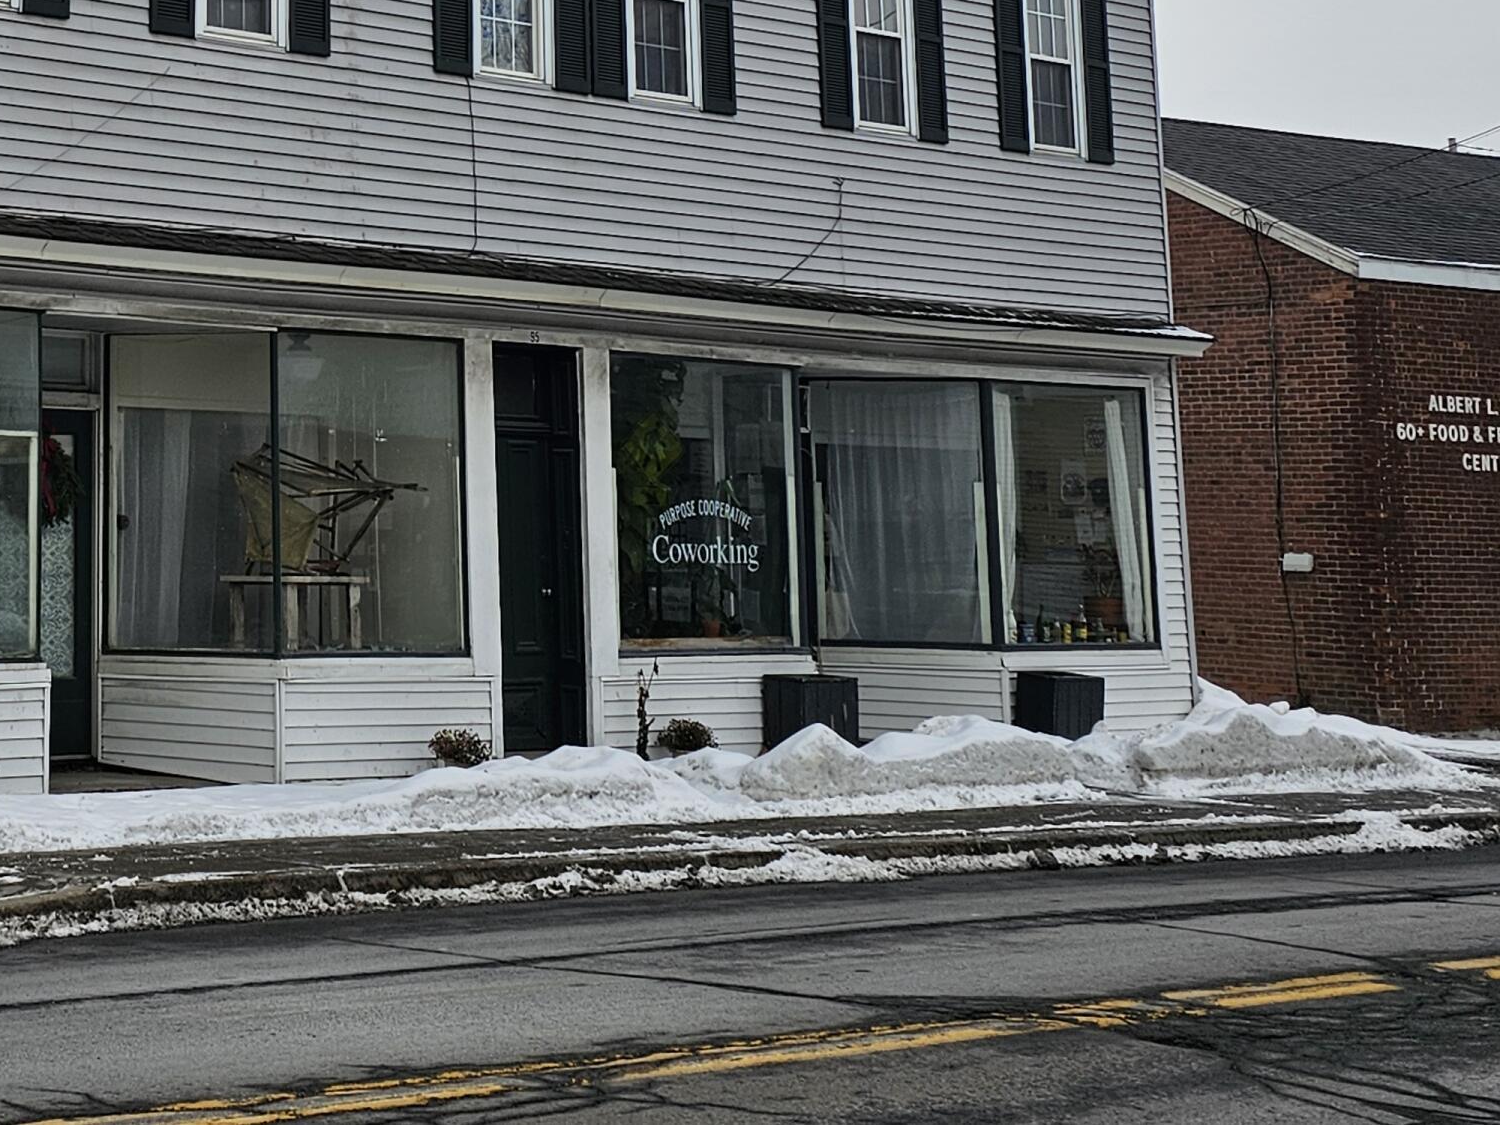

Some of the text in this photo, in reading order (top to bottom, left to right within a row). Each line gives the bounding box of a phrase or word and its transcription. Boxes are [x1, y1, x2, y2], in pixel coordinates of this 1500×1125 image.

[1429, 394, 1481, 414] ALBERT
[1396, 422, 1425, 441] 60+
[1429, 423, 1469, 442] FOOD
[1473, 426, 1485, 443] &
[1462, 453, 1499, 472] CENT
[659, 499, 753, 532] PURPOSE COOPERATIVE
[652, 534, 760, 572] Coworking
